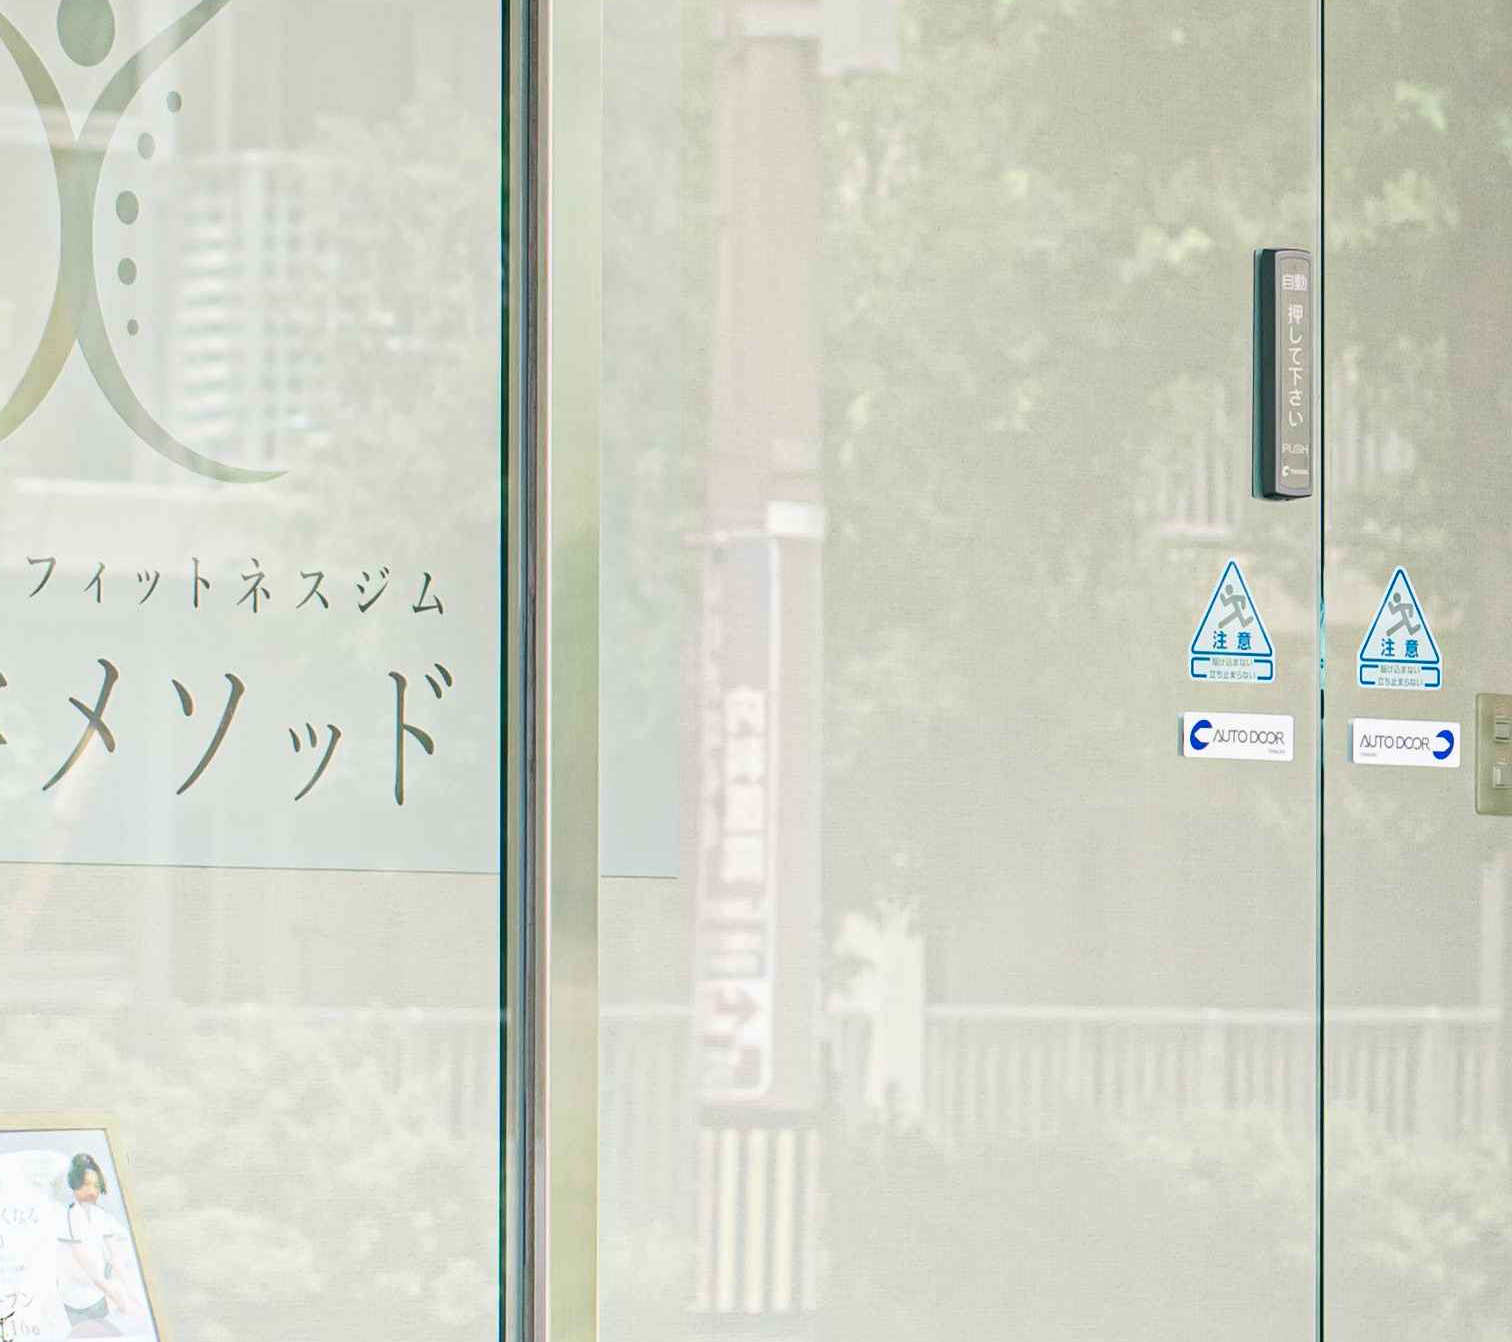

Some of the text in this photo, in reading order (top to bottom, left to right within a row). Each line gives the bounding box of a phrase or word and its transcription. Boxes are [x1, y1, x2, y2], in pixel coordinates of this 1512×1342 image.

[1282, 273, 1308, 291] 自動
[1288, 304, 1304, 427] 押して下さい
[1212, 630, 1251, 650] 注意
[1381, 638, 1419, 658] 注意
[1213, 728, 1285, 745] AUTO DOOR
[1360, 734, 1430, 751] AUTO DOOR
